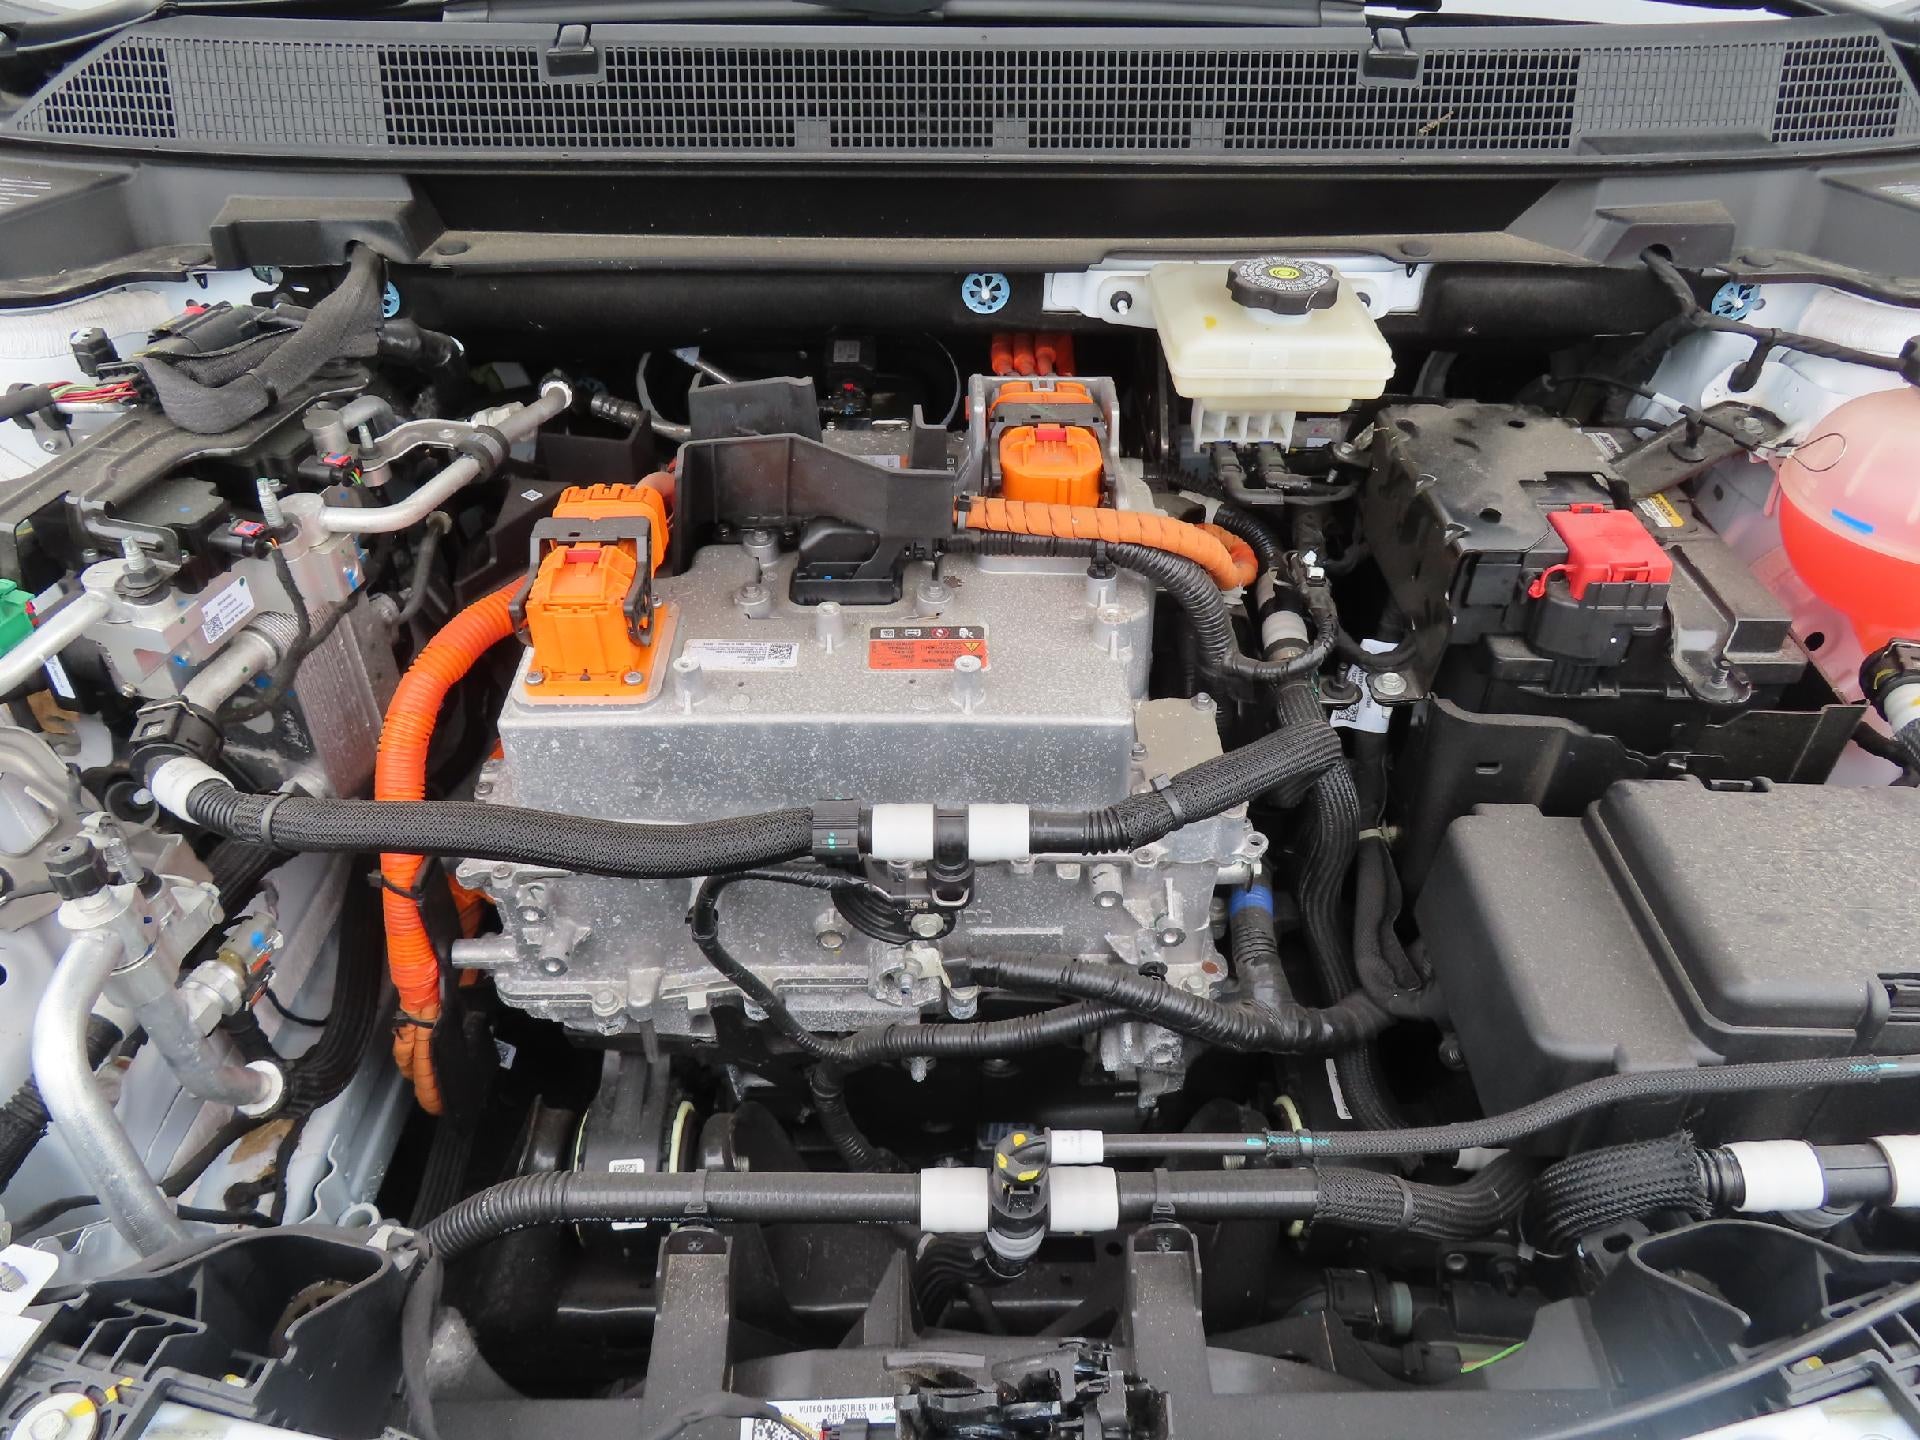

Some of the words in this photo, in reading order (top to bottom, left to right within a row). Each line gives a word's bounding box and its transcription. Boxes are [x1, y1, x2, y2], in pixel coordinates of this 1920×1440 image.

[824, 1403, 867, 1412] INDUSTRIES
[869, 1403, 878, 1411] DE
[881, 1402, 894, 1411] MEX
